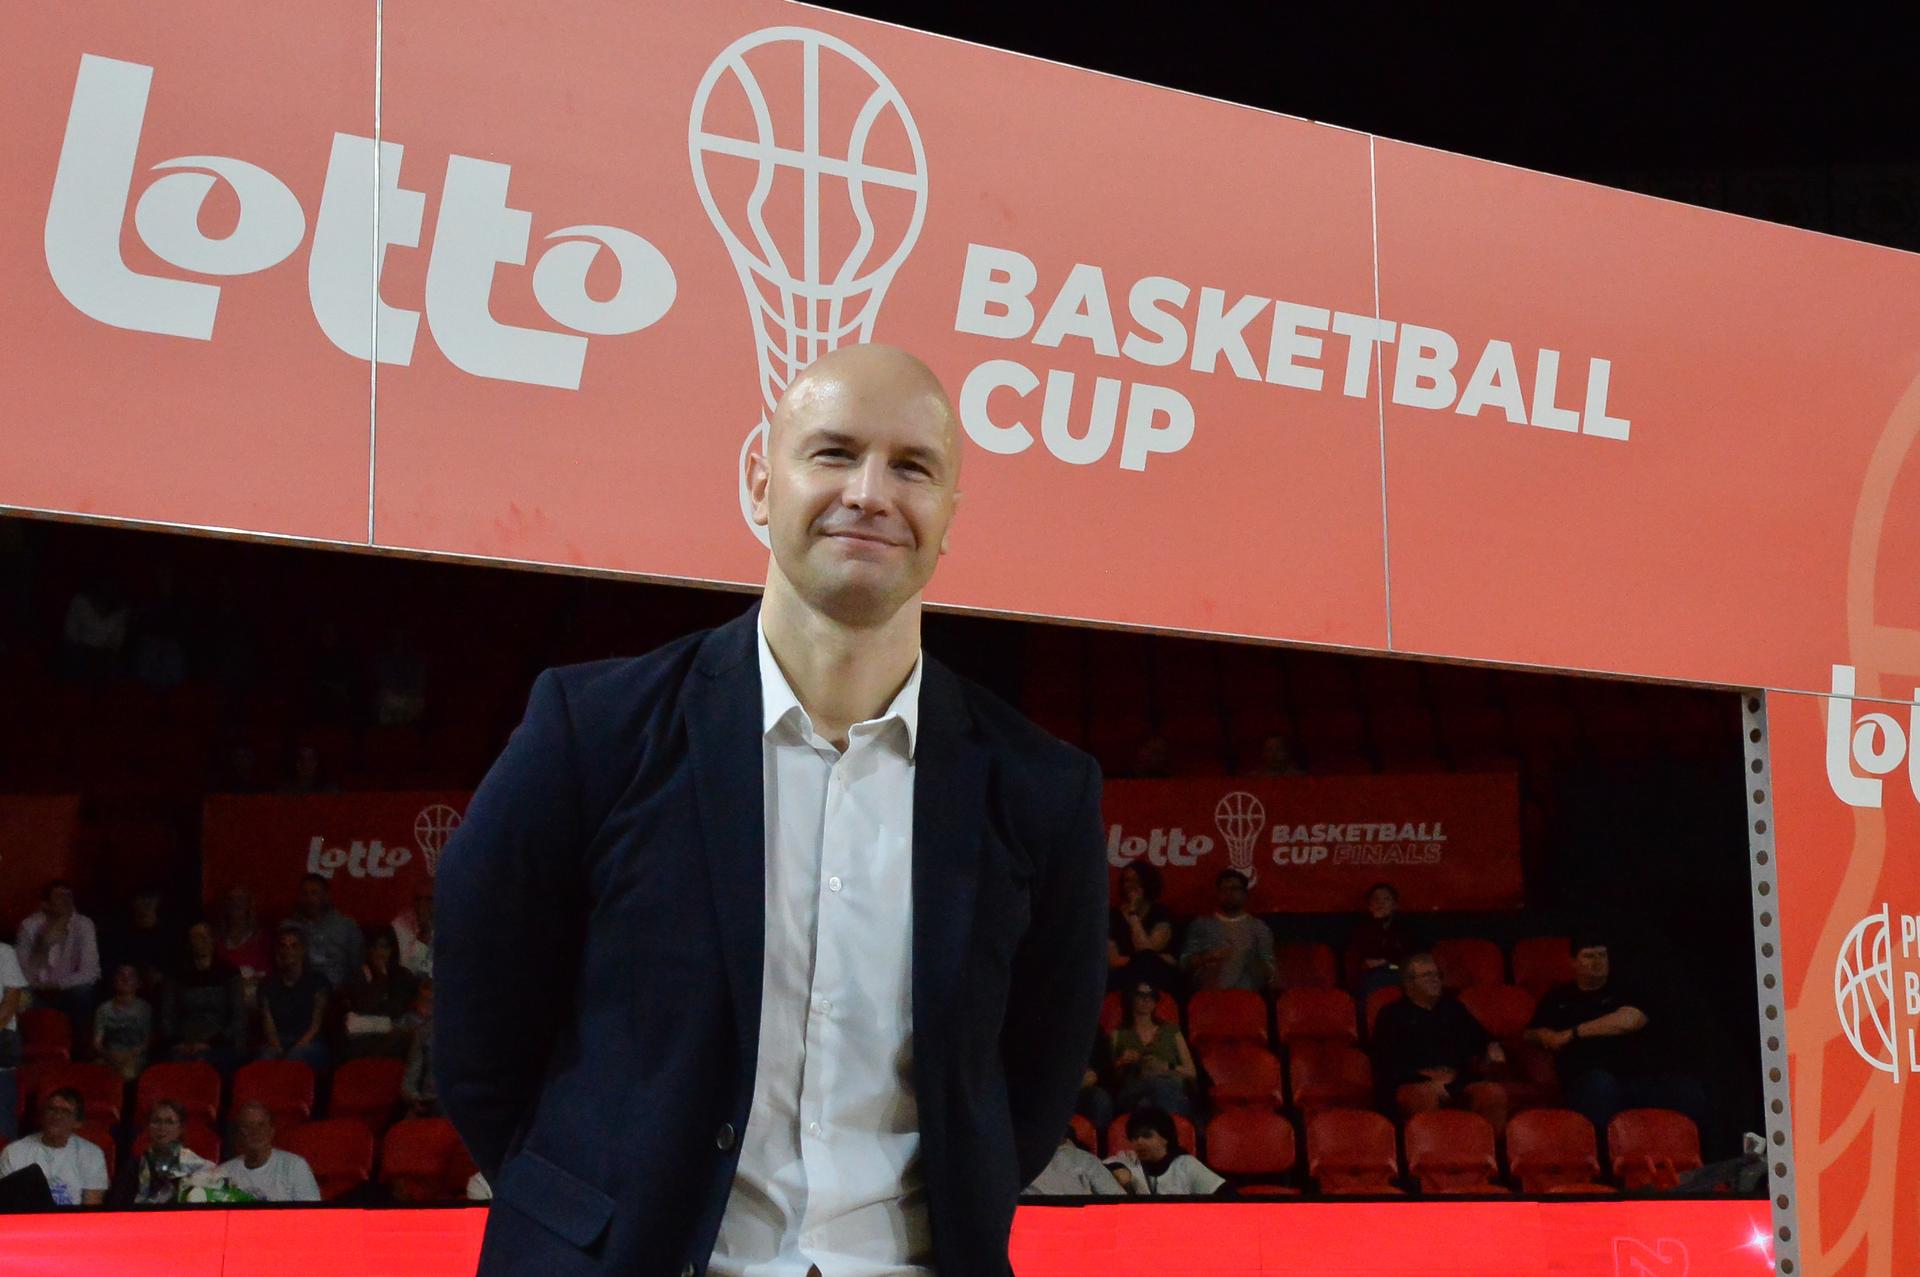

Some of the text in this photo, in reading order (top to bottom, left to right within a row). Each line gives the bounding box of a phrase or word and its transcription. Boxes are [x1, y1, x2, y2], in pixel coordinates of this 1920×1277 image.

[955, 243, 1631, 441] BASKETBALL
[959, 360, 1195, 471] CUP
[1271, 822, 1447, 843] BASKETBALL
[1272, 844, 1442, 865] CUP FINALS
